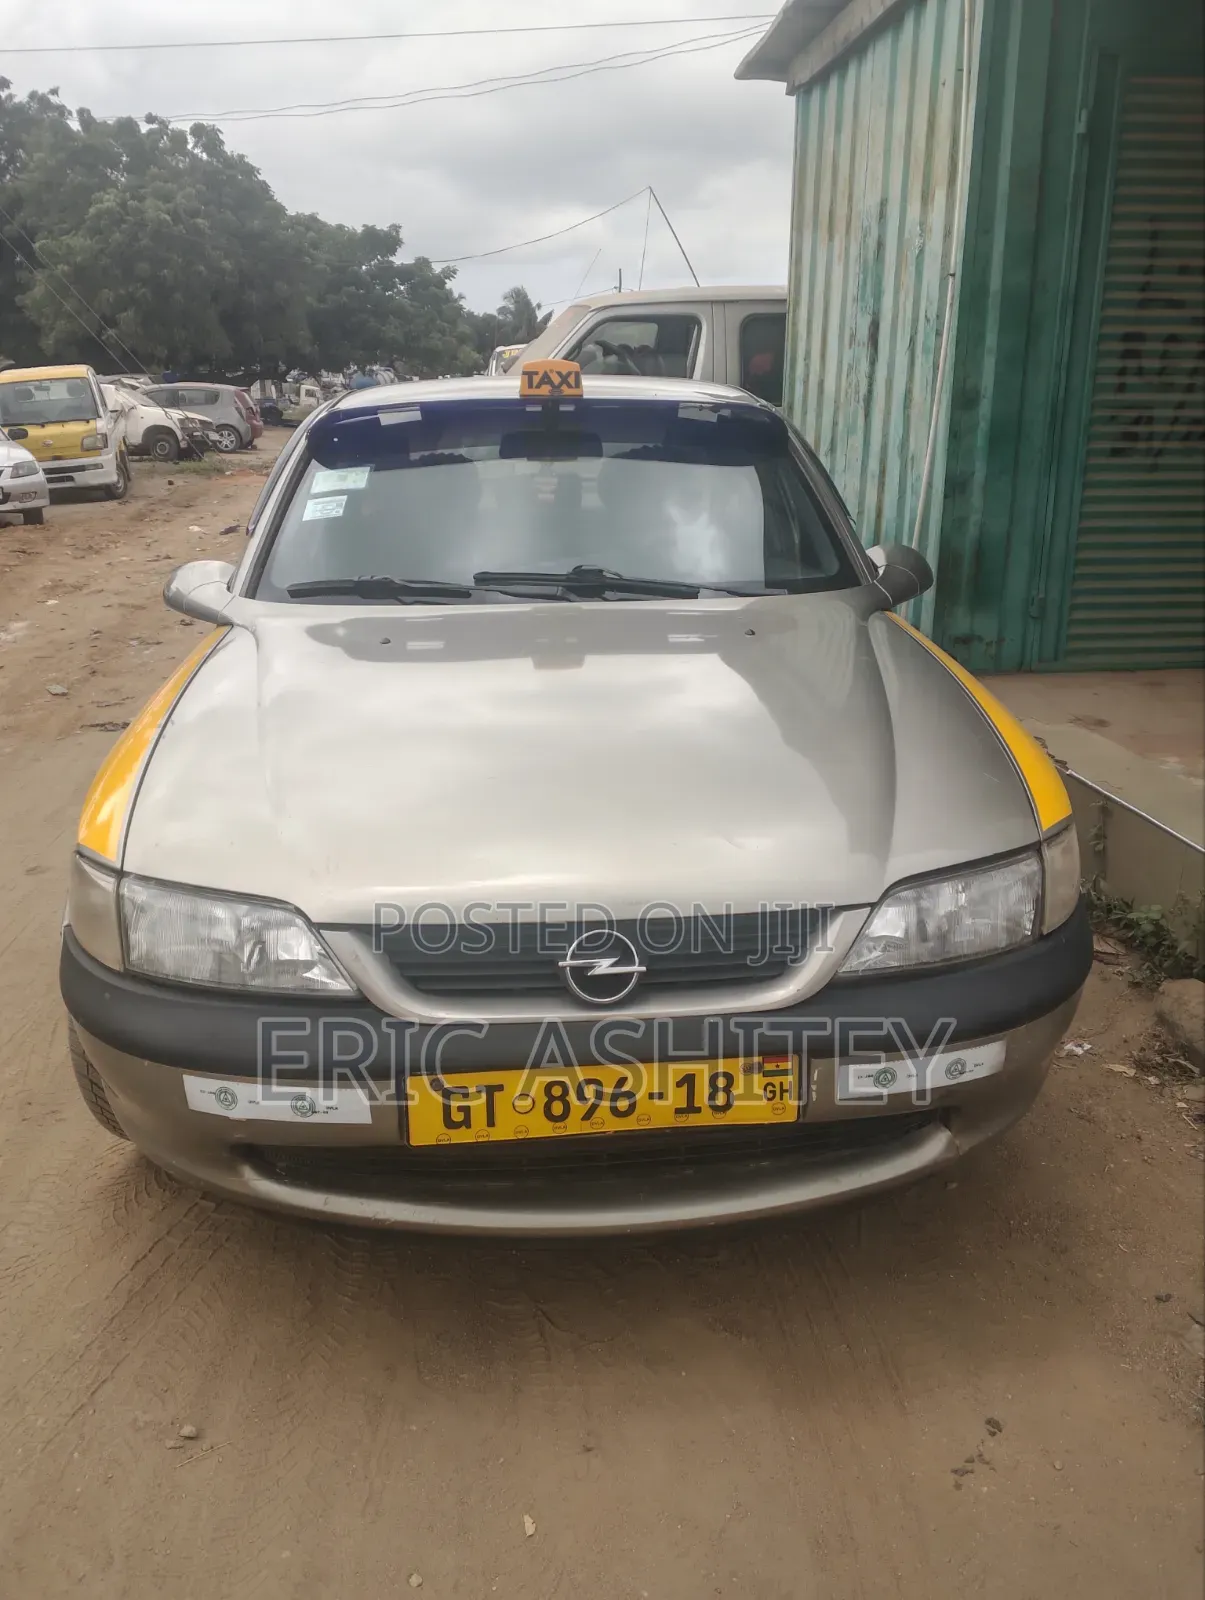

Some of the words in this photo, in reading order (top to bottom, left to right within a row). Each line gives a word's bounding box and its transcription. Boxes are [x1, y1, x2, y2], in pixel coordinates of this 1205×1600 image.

[522, 370, 580, 389] TAXI
[442, 1084, 504, 1130] GT
[543, 1071, 735, 1123] 896-18
[763, 1081, 793, 1102] GH
